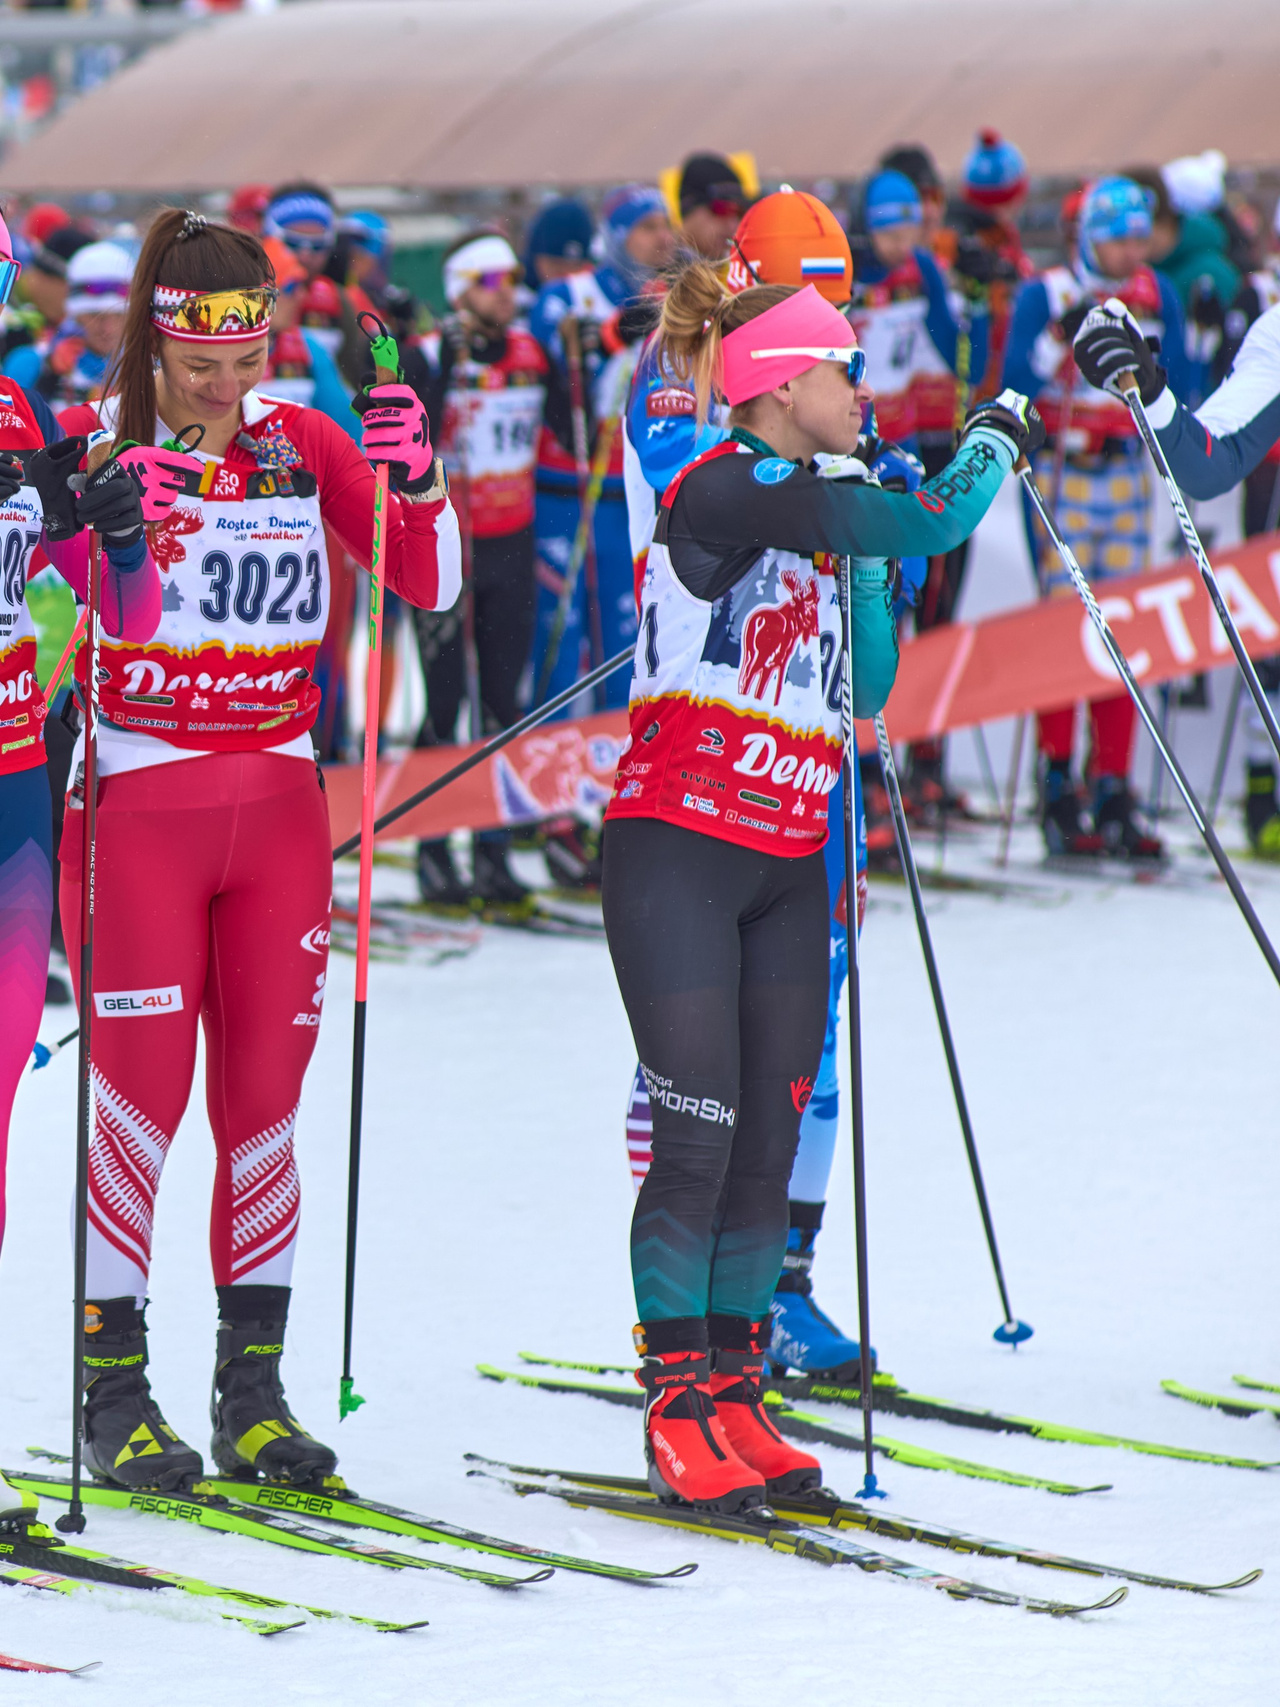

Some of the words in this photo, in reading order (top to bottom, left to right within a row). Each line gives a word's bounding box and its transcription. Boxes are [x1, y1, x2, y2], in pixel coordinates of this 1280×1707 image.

[219, 469, 239, 487] 50
[214, 484, 237, 495] KM
[216, 517, 260, 531] Rostec
[250, 530, 305, 542] marathon
[199, 549, 322, 625] 3023
[126, 716, 178, 729] MADSHUS
[681, 770, 727, 792] BIVIUM
[698, 805, 720, 817] СПОРТ
[699, 799, 714, 808] МОЙ
[738, 816, 779, 834] MADSHUS
[103, 993, 173, 1011] GEL4U
[654, 1371, 697, 1385] SPINE
[652, 1430, 687, 1478] SPINE
[129, 1494, 203, 1522] FISCHER
[255, 1488, 334, 1516] FISCHER
